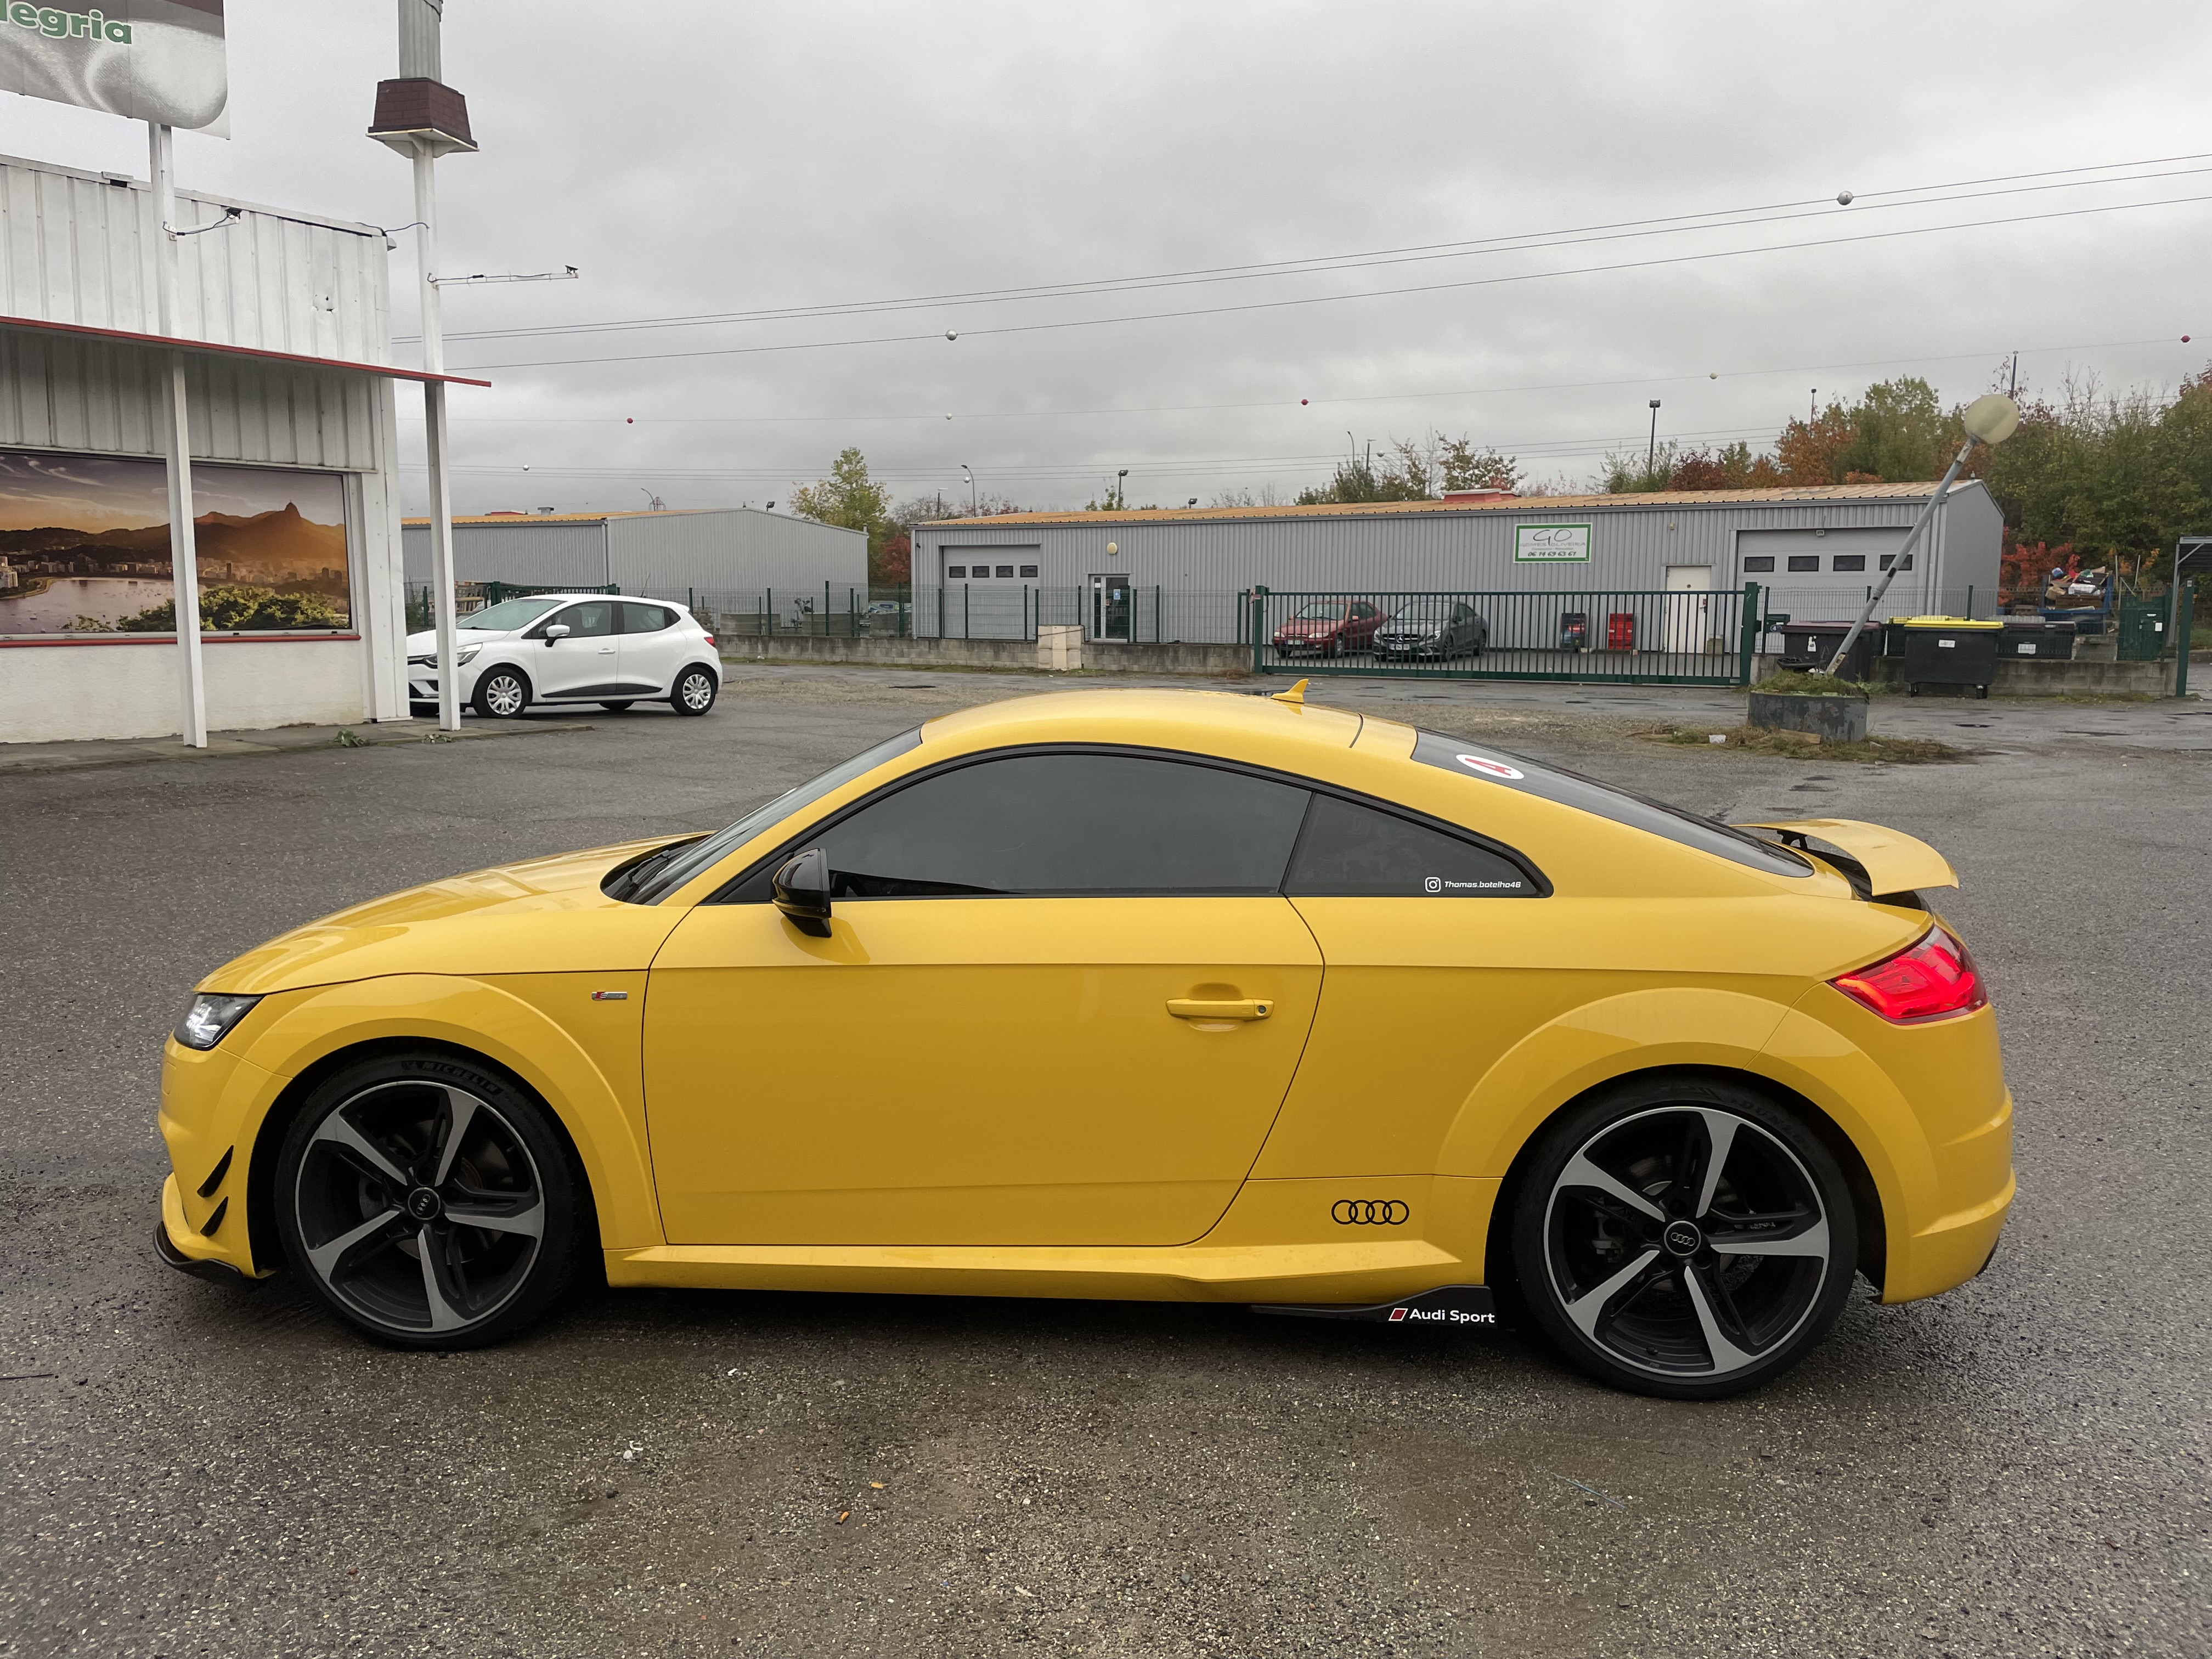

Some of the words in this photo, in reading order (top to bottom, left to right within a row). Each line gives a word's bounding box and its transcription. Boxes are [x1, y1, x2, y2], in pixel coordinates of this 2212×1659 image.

[422, 1061, 499, 1092] MICHELIN
[1409, 1308, 1446, 1321] Audi
[1450, 1310, 1496, 1324] Sport
